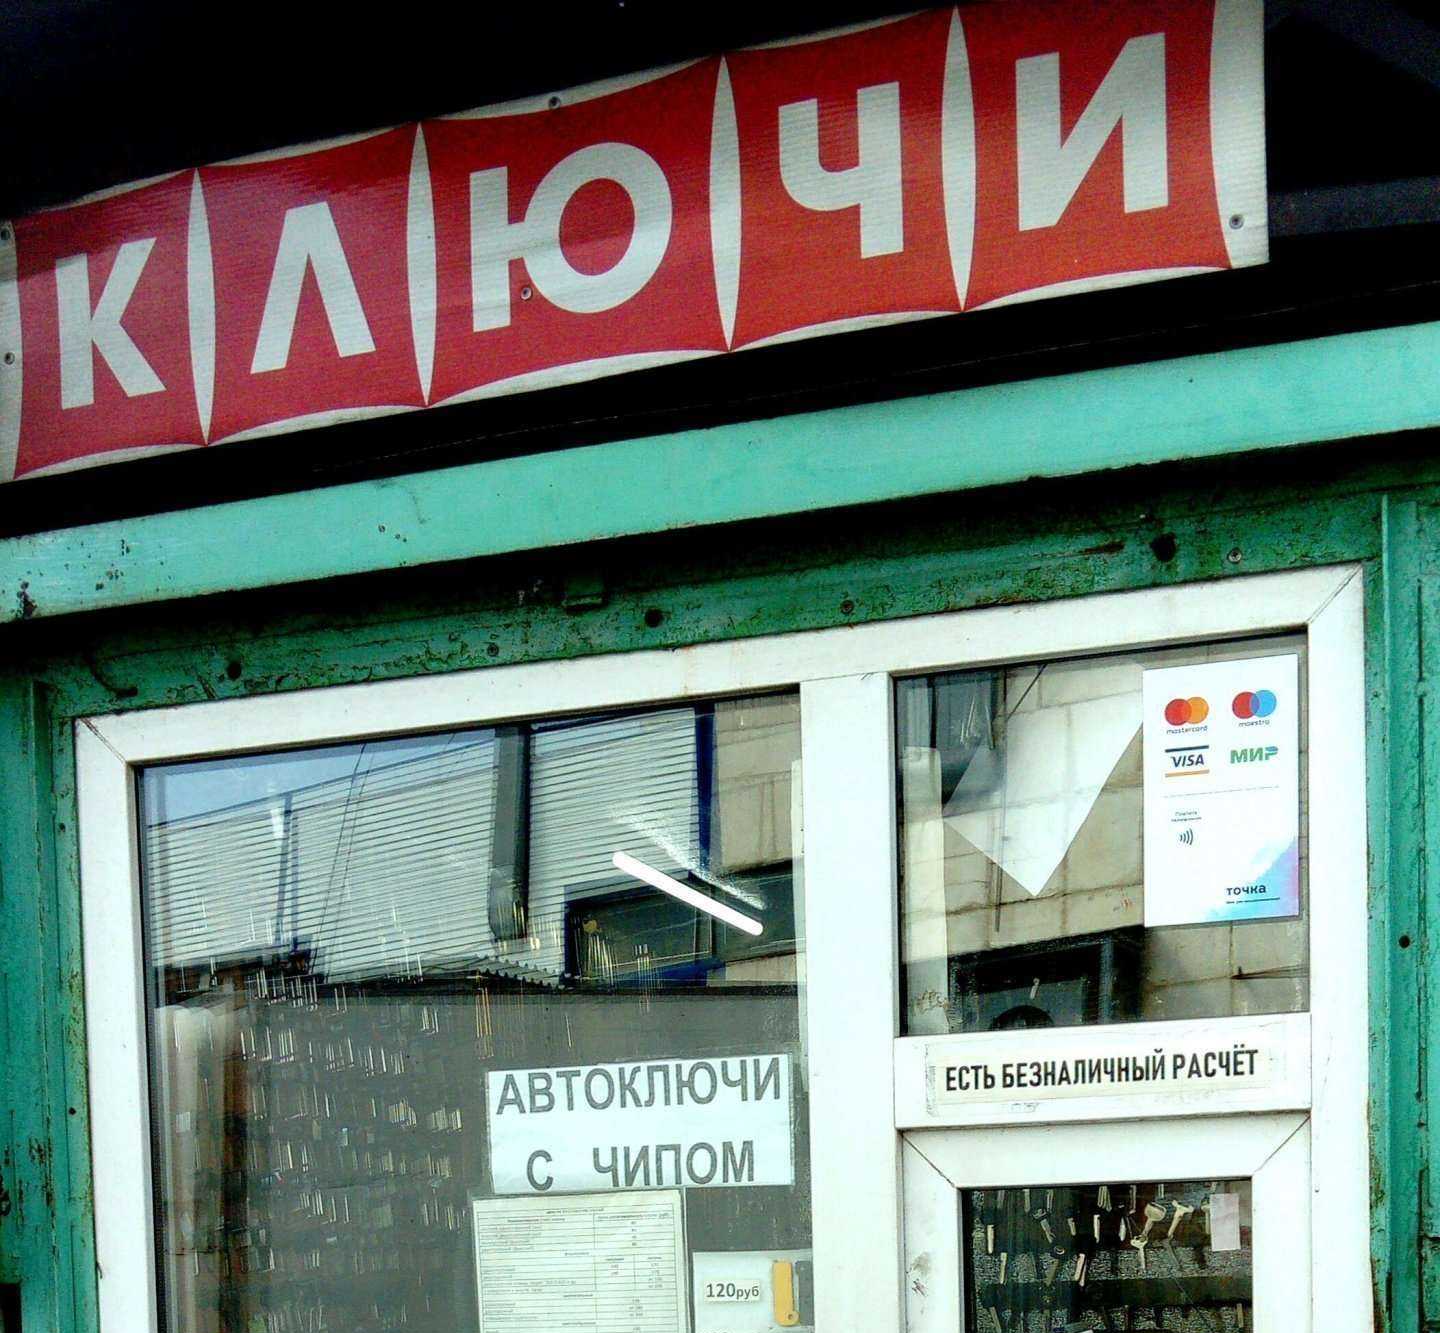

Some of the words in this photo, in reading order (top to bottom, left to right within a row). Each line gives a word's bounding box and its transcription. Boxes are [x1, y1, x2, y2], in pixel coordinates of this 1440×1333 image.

[54, 31, 1170, 411] КЛЮЧИ
[1171, 753, 1205, 768] VISA
[1230, 746, 1279, 764] МИР
[1226, 884, 1266, 897] точка
[496, 1057, 781, 1115] АВТОКЛЮЧИ
[945, 1064, 996, 1091] ЕСТЬ
[1002, 1048, 1166, 1089] БЕЗНАЛИЧНЫЙ
[1172, 1044, 1259, 1080] РАСЧЁТ
[526, 1149, 554, 1191] С
[592, 1140, 755, 1188] ЧИПОМ
